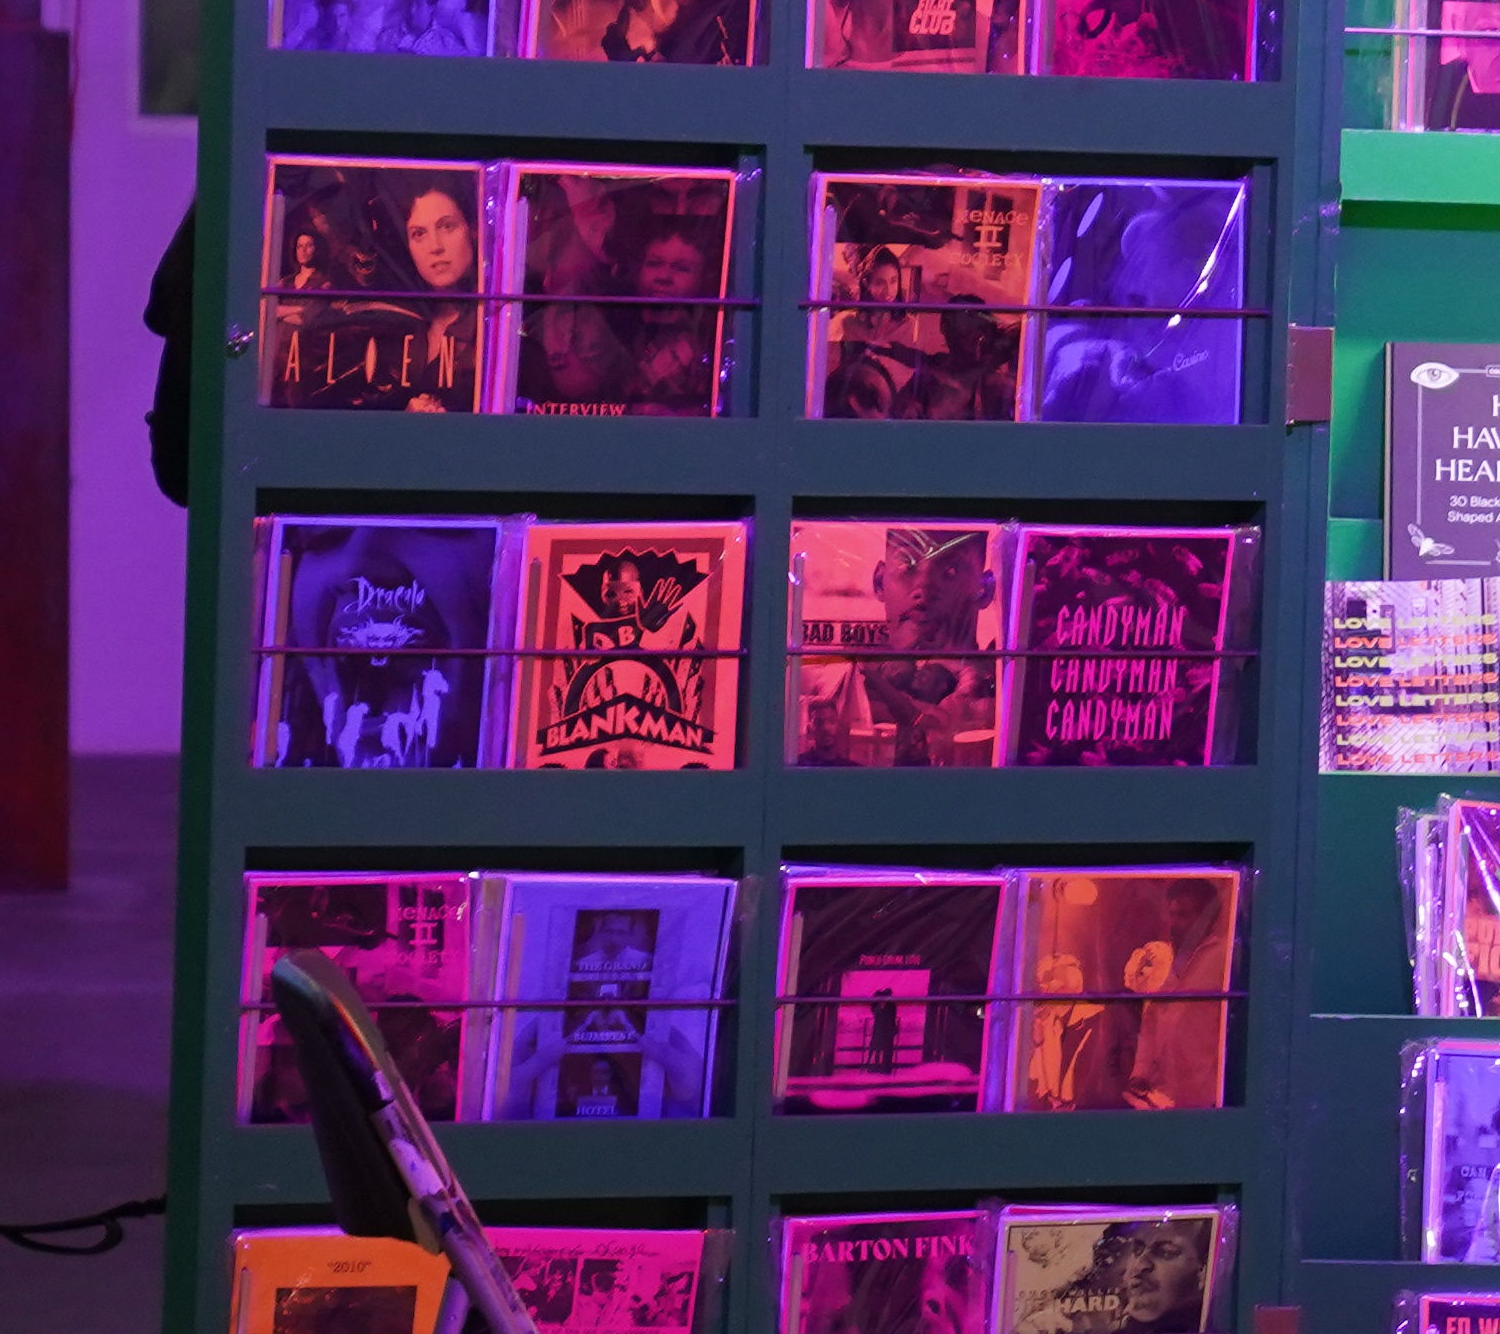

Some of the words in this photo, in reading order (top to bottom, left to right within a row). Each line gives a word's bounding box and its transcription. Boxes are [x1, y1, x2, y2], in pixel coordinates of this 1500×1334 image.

[908, 11, 955, 36] CLUB
[283, 331, 455, 390] ALIEN
[1173, 350, 1211, 373] Casino
[526, 402, 627, 417] INTERVIEW
[1449, 495, 1467, 508] 30
[1470, 495, 1500, 508] Black
[1447, 510, 1494, 524] Shaped
[345, 576, 426, 614] Dracula
[1056, 605, 1186, 647] CANDYMAN
[1334, 616, 1393, 631] LOVE
[801, 621, 835, 645] BAD
[840, 623, 890, 645] BOYS
[1334, 635, 1393, 649] LOVE
[1396, 633, 1498, 647] LETTERS
[1334, 655, 1394, 669] LOVE
[1399, 652, 1499, 666] LETTERS
[1050, 657, 1178, 694] CANDYMAN
[1335, 674, 1394, 688] LOVE
[1400, 672, 1499, 687] LETTERS
[1335, 694, 1394, 707] LOVE
[1401, 691, 1499, 706] LETTERS
[545, 702, 702, 748] BLANKMAN
[1045, 699, 1174, 742] CANDYMAN
[1336, 713, 1394, 727] LOVE
[1401, 711, 1499, 726] LETTERS
[1336, 733, 1394, 746] LOVE
[1402, 731, 1499, 745] LETTERS
[1337, 752, 1395, 766] LOVE
[804, 1236, 910, 1264] BARTON
[914, 1234, 975, 1258] FINK
[1060, 1294, 1121, 1313] HARD
